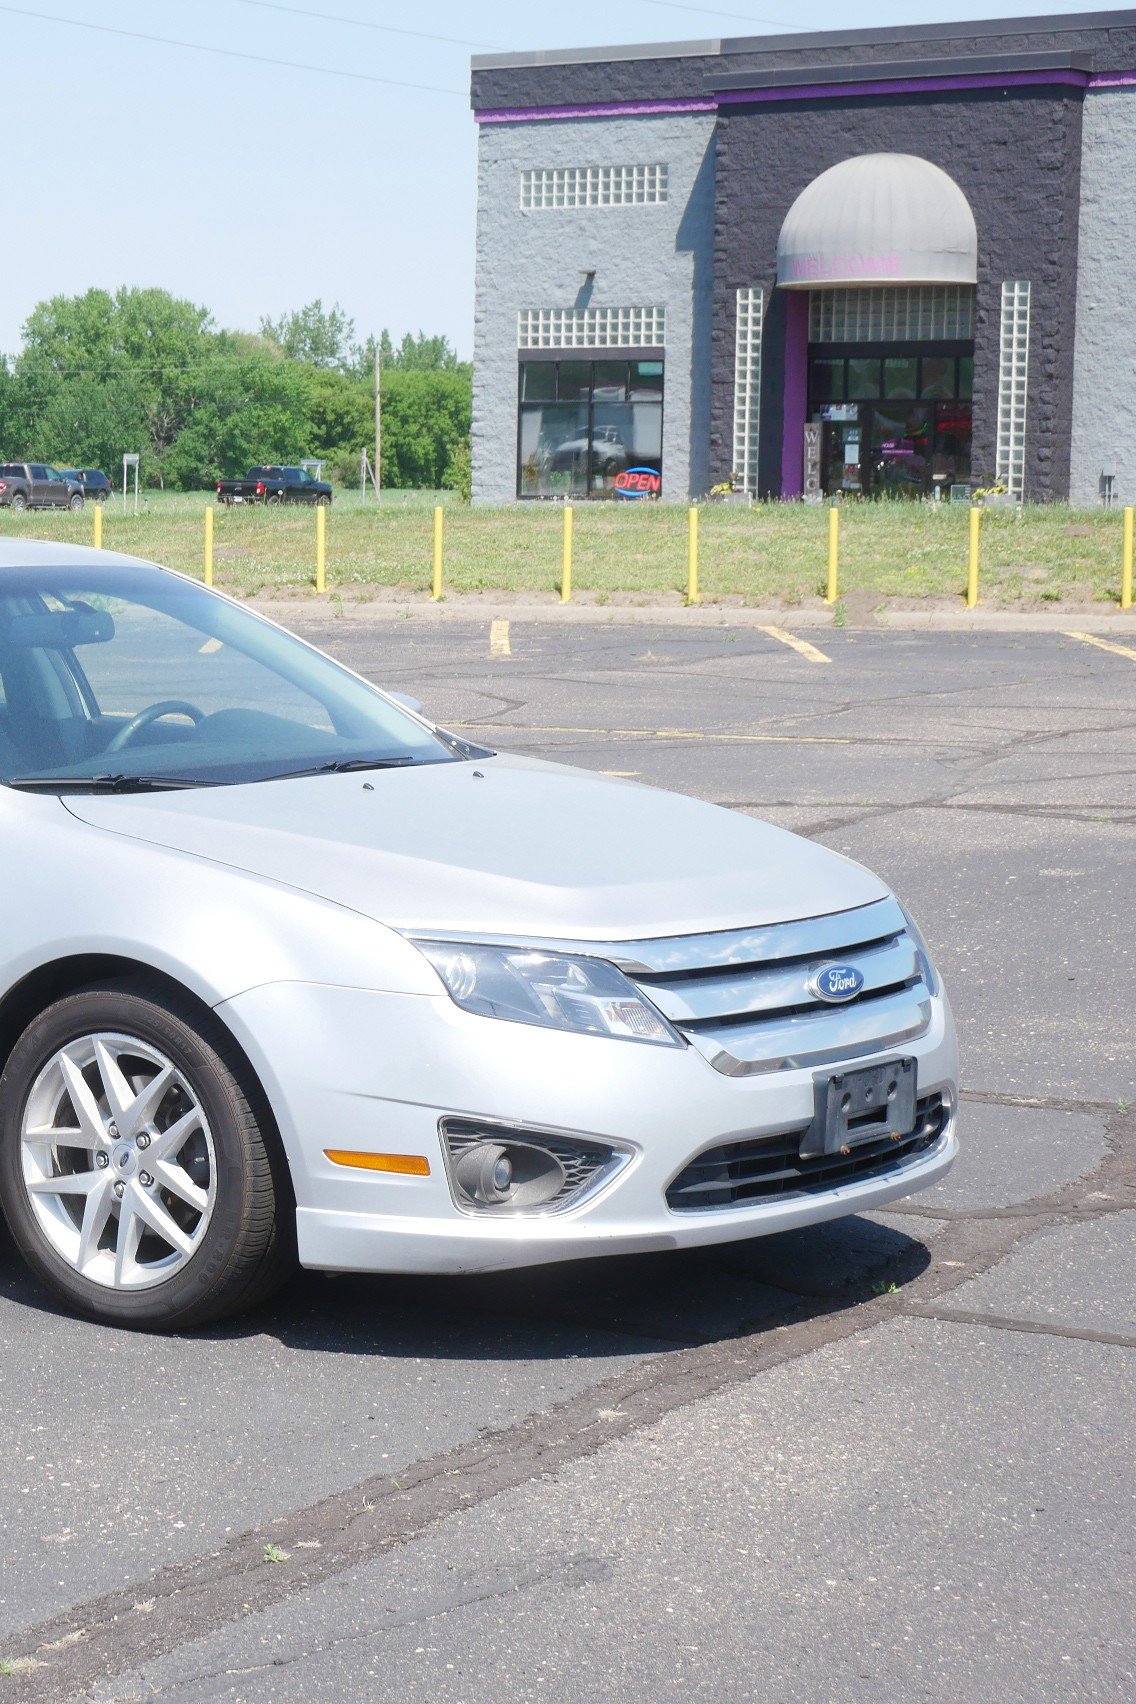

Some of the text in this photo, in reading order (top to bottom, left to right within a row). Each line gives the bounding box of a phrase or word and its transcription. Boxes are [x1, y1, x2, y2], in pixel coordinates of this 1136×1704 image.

[792, 255, 901, 278] WELCOME
[805, 431, 819, 490] WELC
[615, 472, 661, 492] OPEN
[829, 969, 856, 992] Ford
